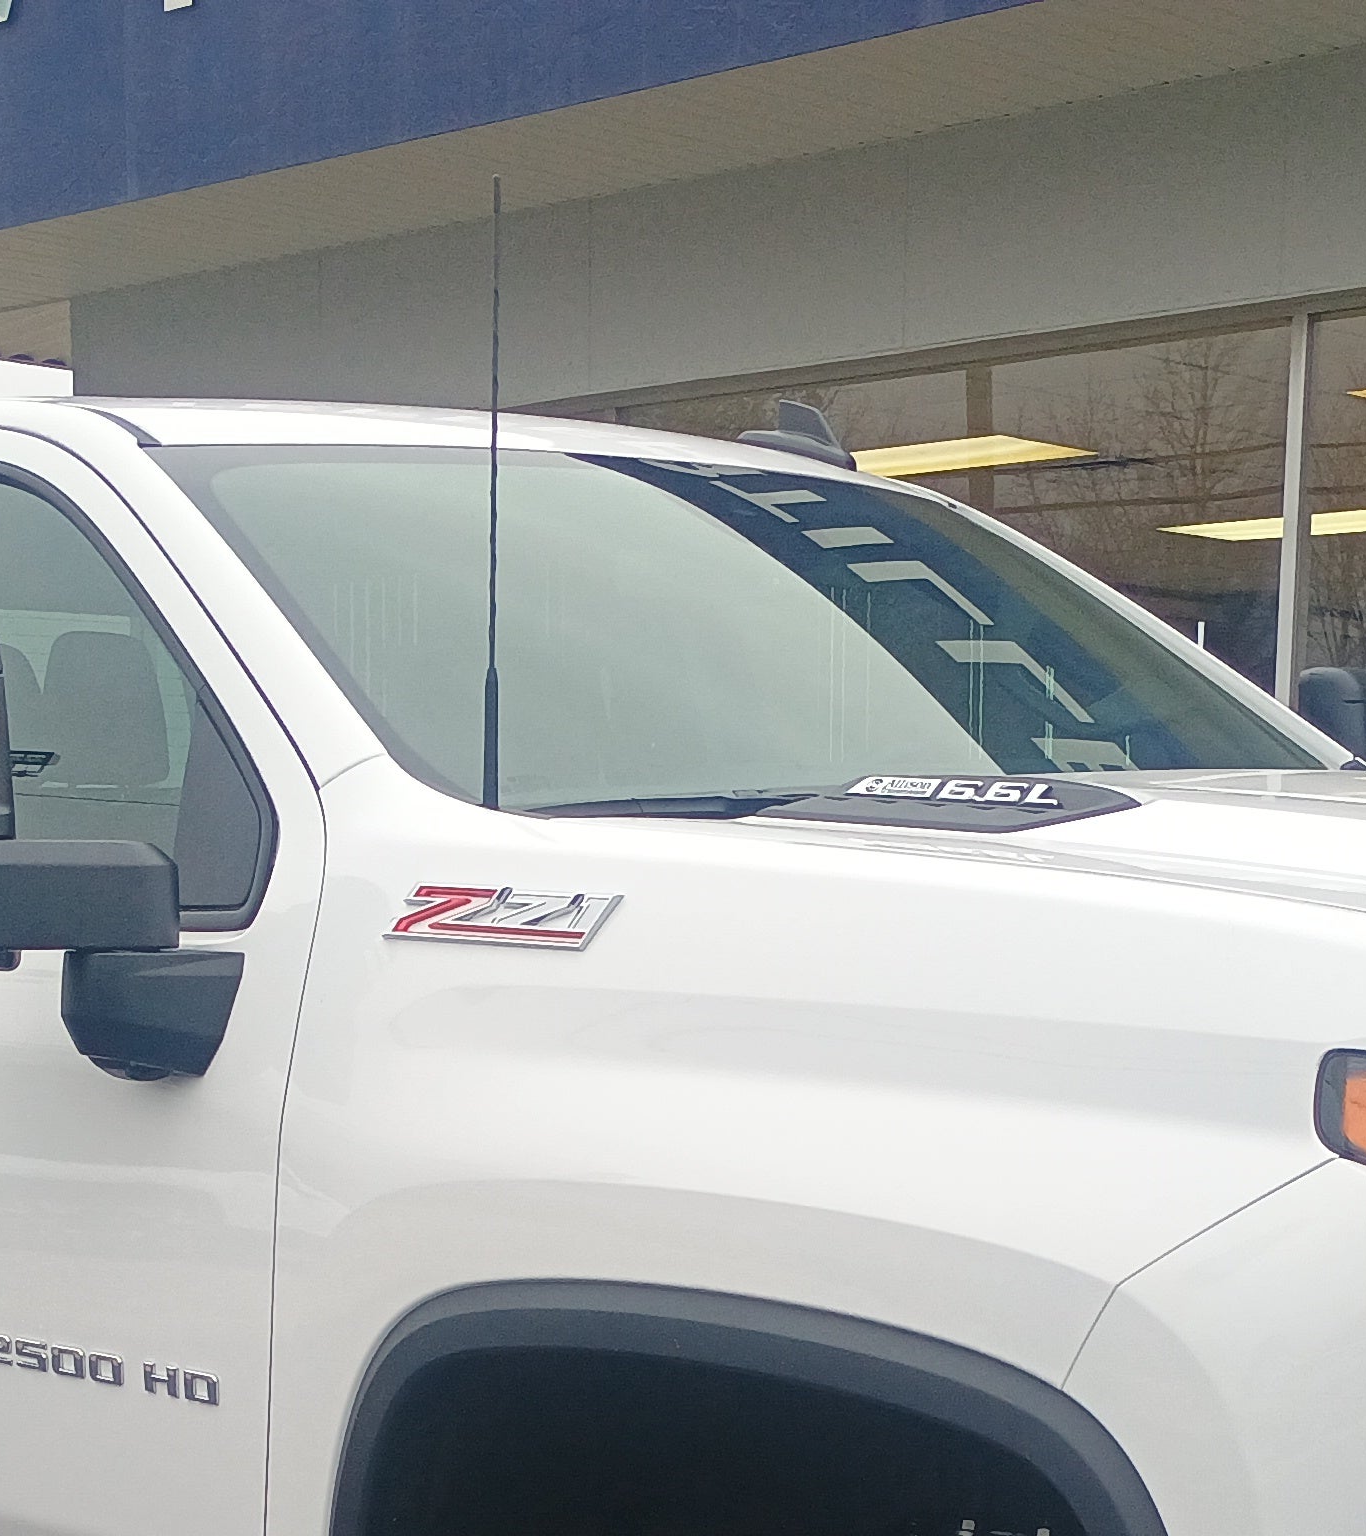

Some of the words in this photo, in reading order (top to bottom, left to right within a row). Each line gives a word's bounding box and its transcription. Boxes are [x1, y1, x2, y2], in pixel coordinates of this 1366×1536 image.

[881, 779, 932, 791] Allison
[936, 778, 1059, 806] 6.6L
[381, 881, 625, 952] Z71
[143, 1360, 220, 1407] HD
